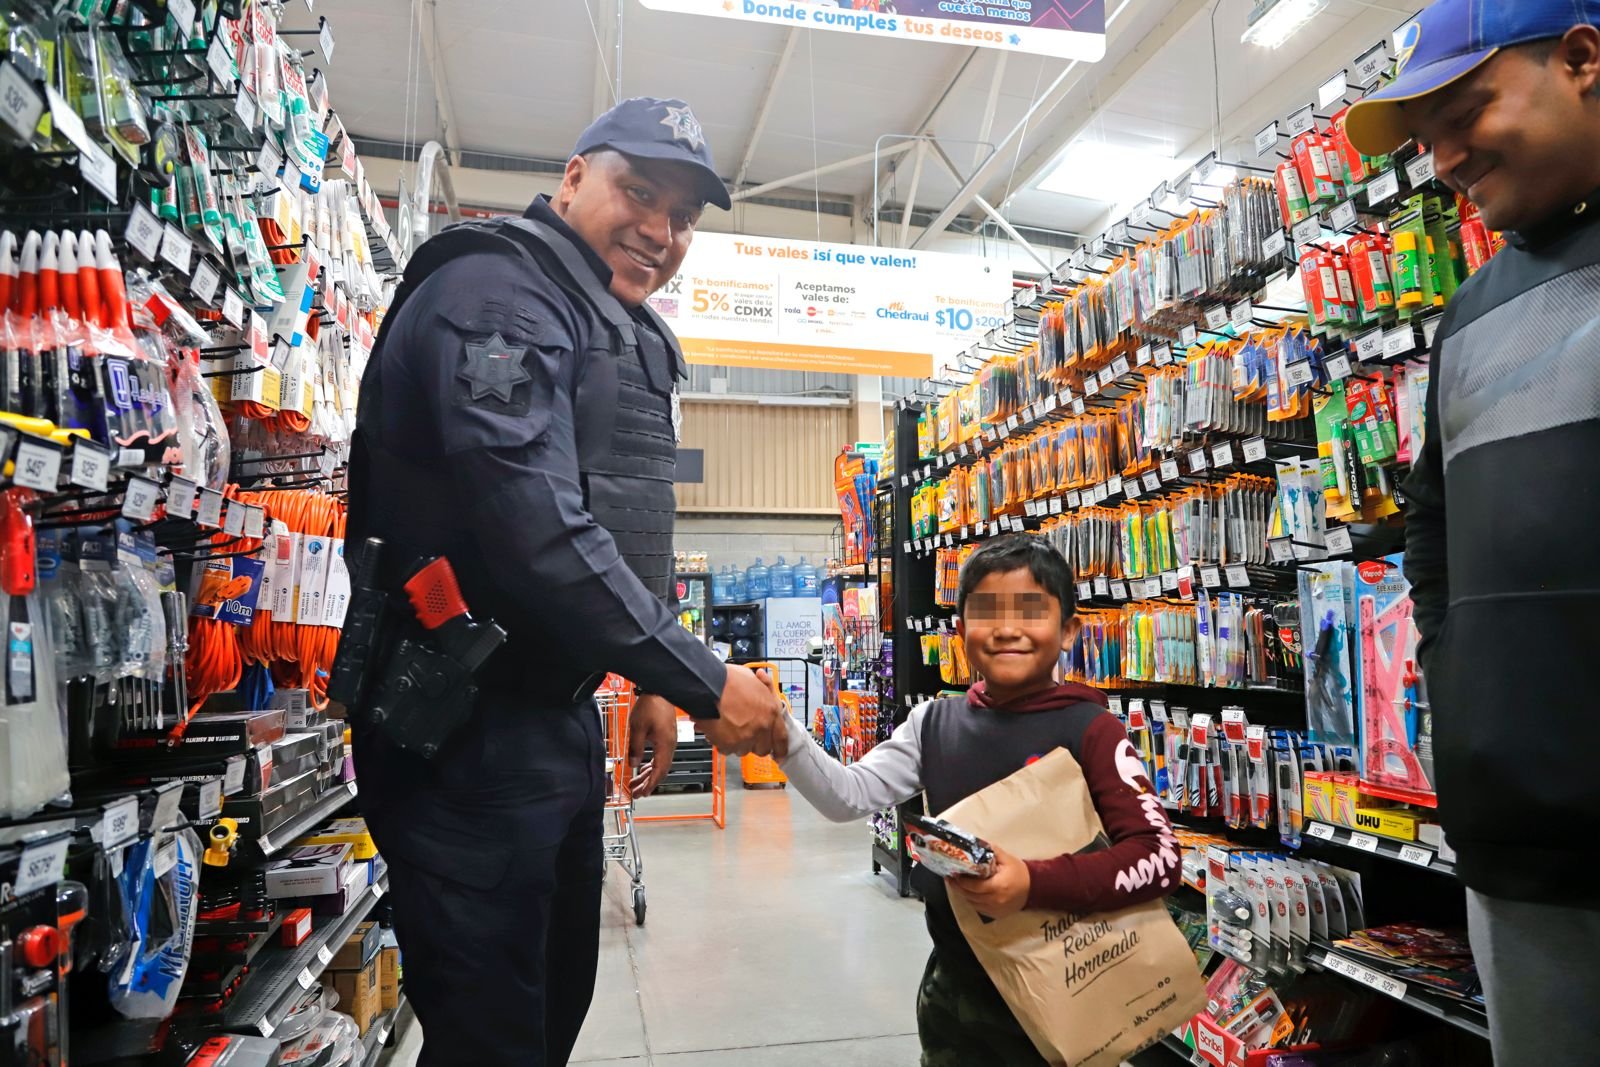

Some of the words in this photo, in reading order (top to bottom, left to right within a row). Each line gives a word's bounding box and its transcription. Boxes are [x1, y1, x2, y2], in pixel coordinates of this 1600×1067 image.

[939, 2, 985, 16] cuesta
[987, 7, 1031, 22] menos
[743, 1, 806, 20] Donde
[813, 11, 897, 32] cumples
[904, 18, 934, 36] tus
[940, 22, 1003, 42] deseos
[312, 176, 317, 184] 2
[735, 242, 762, 256] Tus
[768, 245, 808, 260] vales
[814, 249, 831, 262] ¡sí
[836, 252, 865, 265] que
[870, 254, 917, 268] valen!
[691, 277, 704, 286] Te
[795, 281, 856, 294] Aceptamos
[692, 288, 730, 312] 5%
[802, 293, 829, 303] vales
[833, 295, 849, 304] de:
[936, 296, 946, 304] Te
[1380, 293, 1386, 301] 1
[734, 306, 773, 318] CDMX
[876, 308, 929, 322] Chedraui
[936, 307, 973, 331] $10
[1348, 452, 1360, 506] ESCOLAR
[225, 598, 253, 617] 10m
[776, 621, 785, 629] EL
[786, 621, 811, 629] AMOR
[772, 630, 782, 638] AL
[783, 629, 816, 638] CUERPO
[774, 648, 785, 656] EN
[1356, 813, 1381, 829] UHU
[1065, 929, 1140, 989] Horneada
[1200, 1030, 1223, 1055] Scribe
